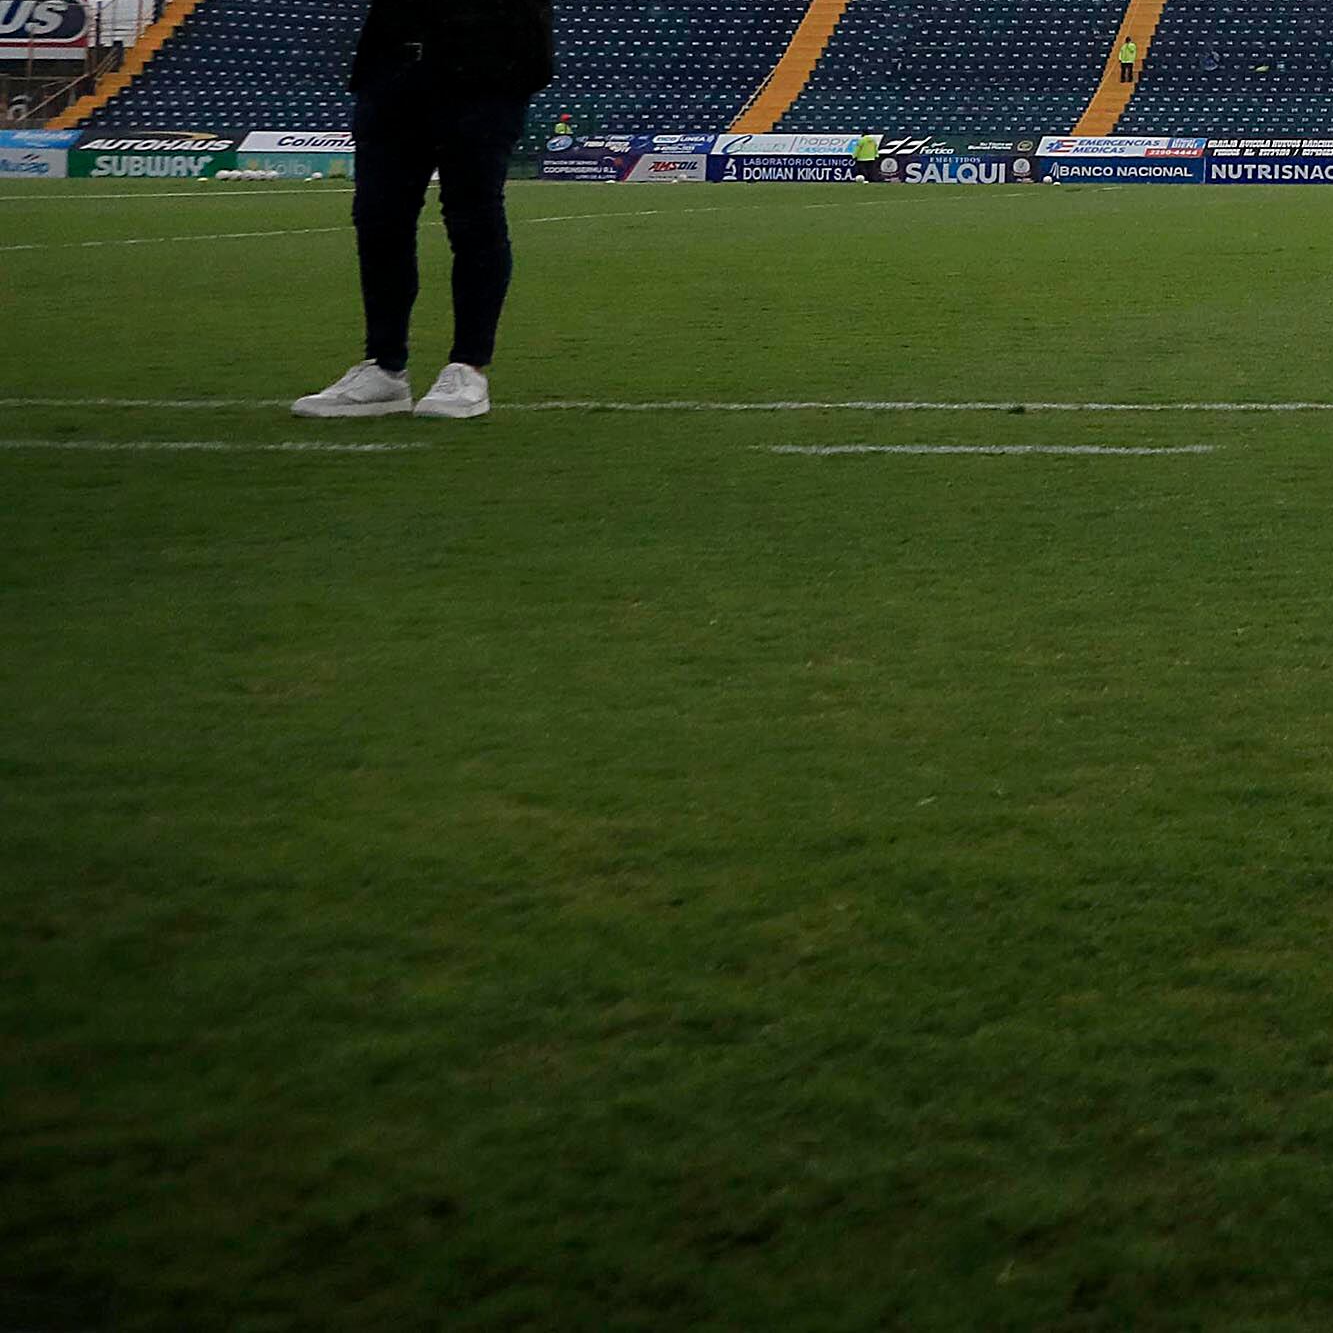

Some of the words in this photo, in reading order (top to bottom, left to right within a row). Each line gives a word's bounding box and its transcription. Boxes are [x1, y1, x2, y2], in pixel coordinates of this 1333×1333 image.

[80, 139, 234, 150] AUTOHAUS
[800, 136, 849, 148] happy
[1076, 139, 1161, 147] EMERGENCIAS
[1073, 146, 1126, 154] MEDICAS
[91, 155, 214, 177] SUBWAY
[649, 161, 698, 172] AMSOIL
[744, 158, 814, 166] LABORATORIO
[743, 168, 794, 181] DOMIAN
[797, 168, 832, 181] KIKUT
[905, 163, 1005, 184] SALQUI
[1060, 167, 1113, 177] BANCO
[1116, 167, 1193, 177] NACIONAL
